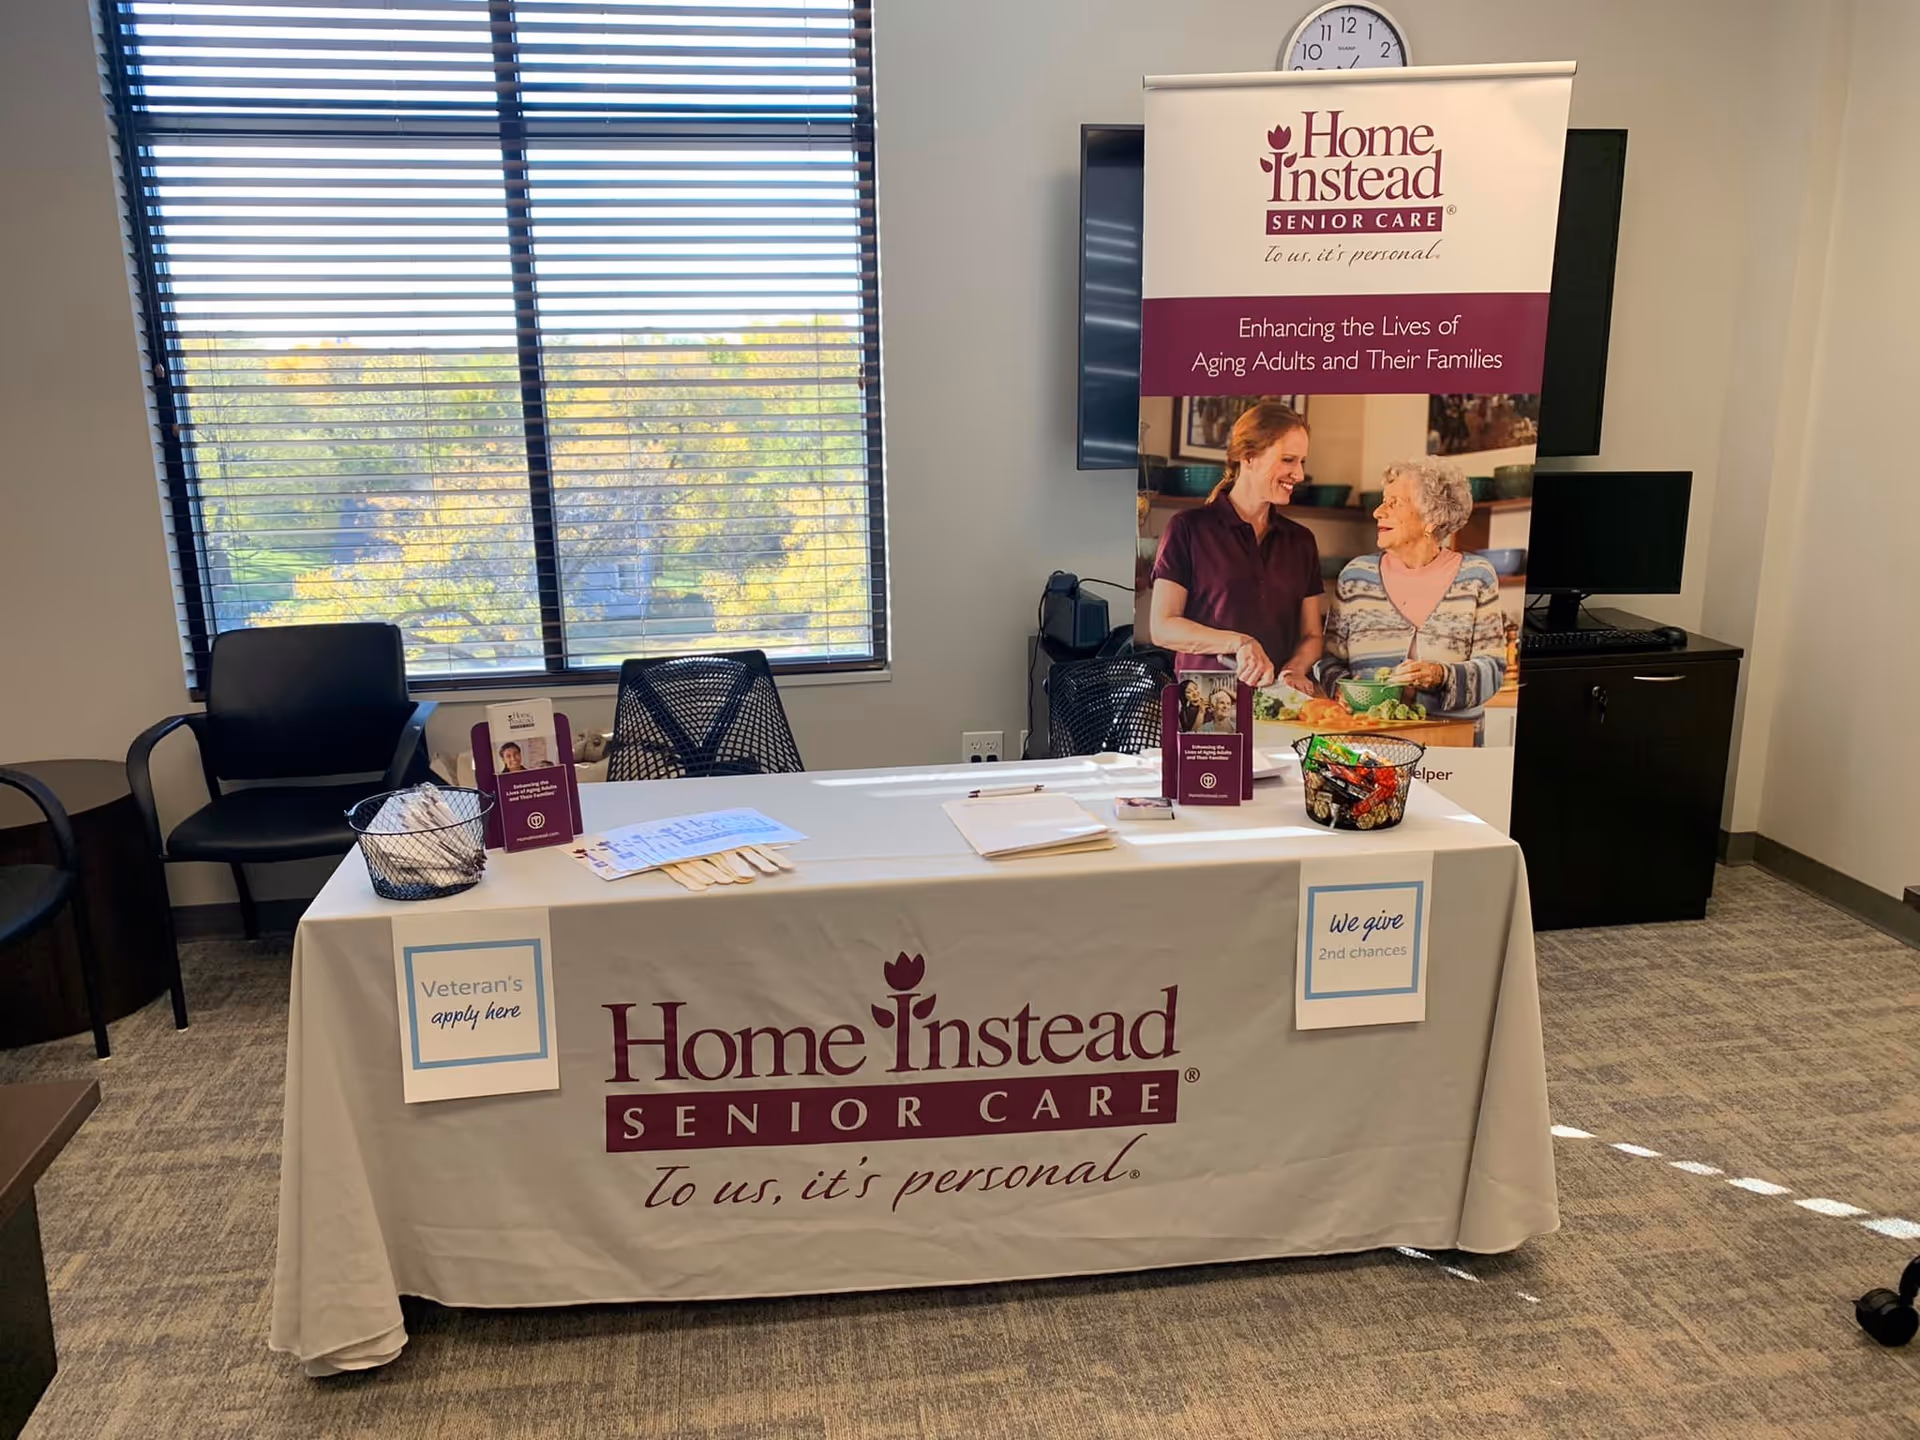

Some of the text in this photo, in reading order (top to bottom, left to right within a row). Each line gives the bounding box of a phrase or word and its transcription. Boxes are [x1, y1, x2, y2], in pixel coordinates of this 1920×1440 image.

[1321, 24, 1332, 41] 11
[1340, 16, 1357, 34] 12
[1368, 23, 1373, 41] 1
[1302, 43, 1323, 61] 10
[1380, 41, 1391, 58] 2
[1299, 110, 1435, 158] Home
[1267, 149, 1444, 202] Instead
[1272, 213, 1363, 230] SENIOR
[1375, 211, 1437, 228] CARE
[1264, 245, 1283, 263] To
[1317, 244, 1345, 262] it's
[1239, 314, 1462, 343] Enhancing the Lives of
[1191, 348, 1503, 377] Aging Adults and Their Families
[1329, 909, 1404, 942] We give
[1318, 946, 1408, 960] 2nd chances
[421, 975, 523, 998] Veteran's
[431, 1001, 521, 1030] apply here
[601, 984, 1180, 1083] Home Instead
[622, 1097, 923, 1140] SENIOR
[979, 1082, 1160, 1124] CARE
[645, 1165, 696, 1209] To
[712, 1172, 783, 1207] us,
[801, 1155, 881, 1200] it's
